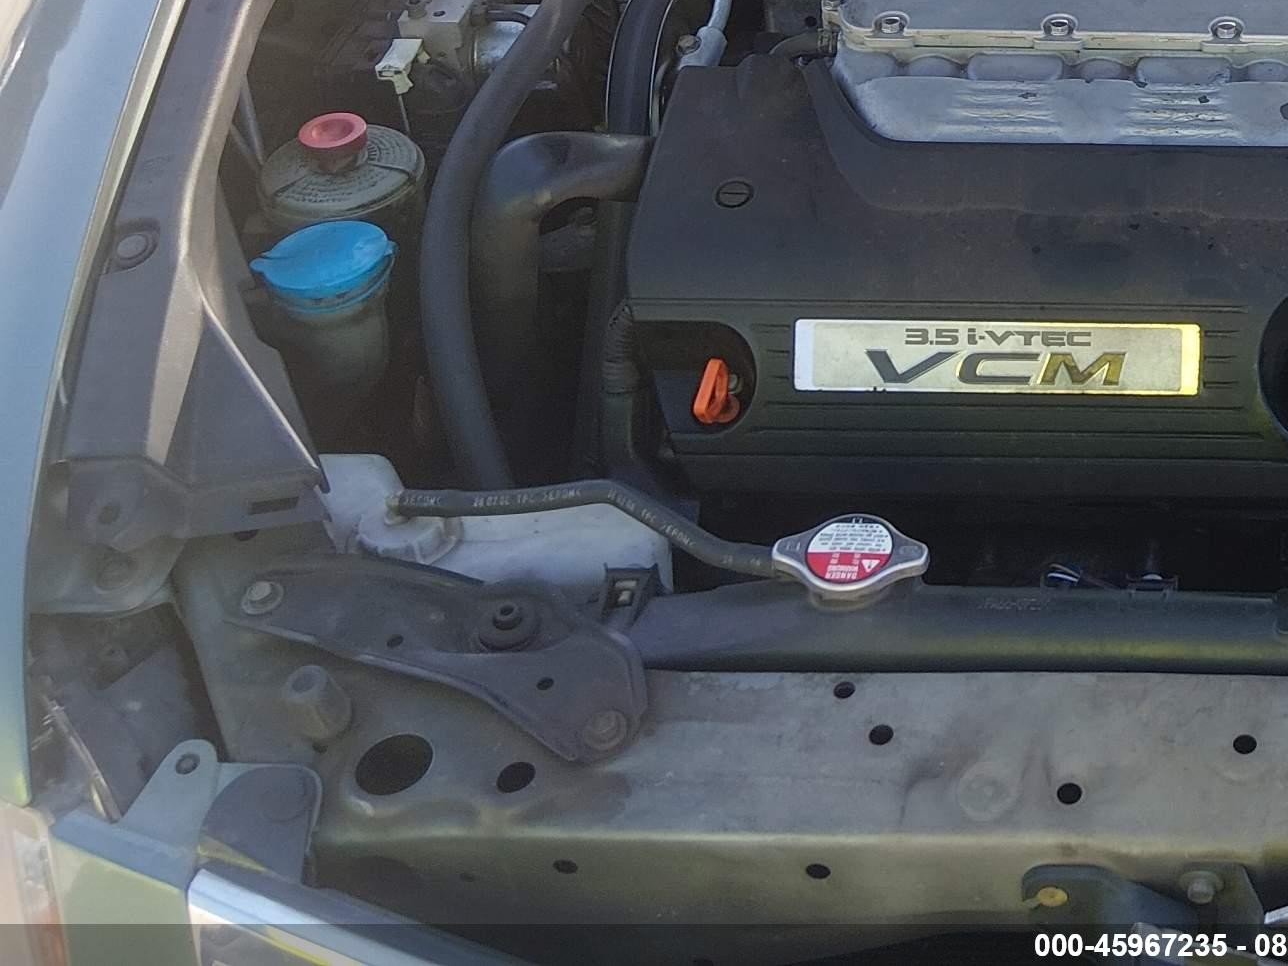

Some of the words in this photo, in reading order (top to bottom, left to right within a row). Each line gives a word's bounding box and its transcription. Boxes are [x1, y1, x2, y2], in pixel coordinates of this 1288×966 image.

[904, 328, 958, 346] 3.5
[967, 328, 1092, 347] i-VTEC
[865, 348, 1127, 387] VCM
